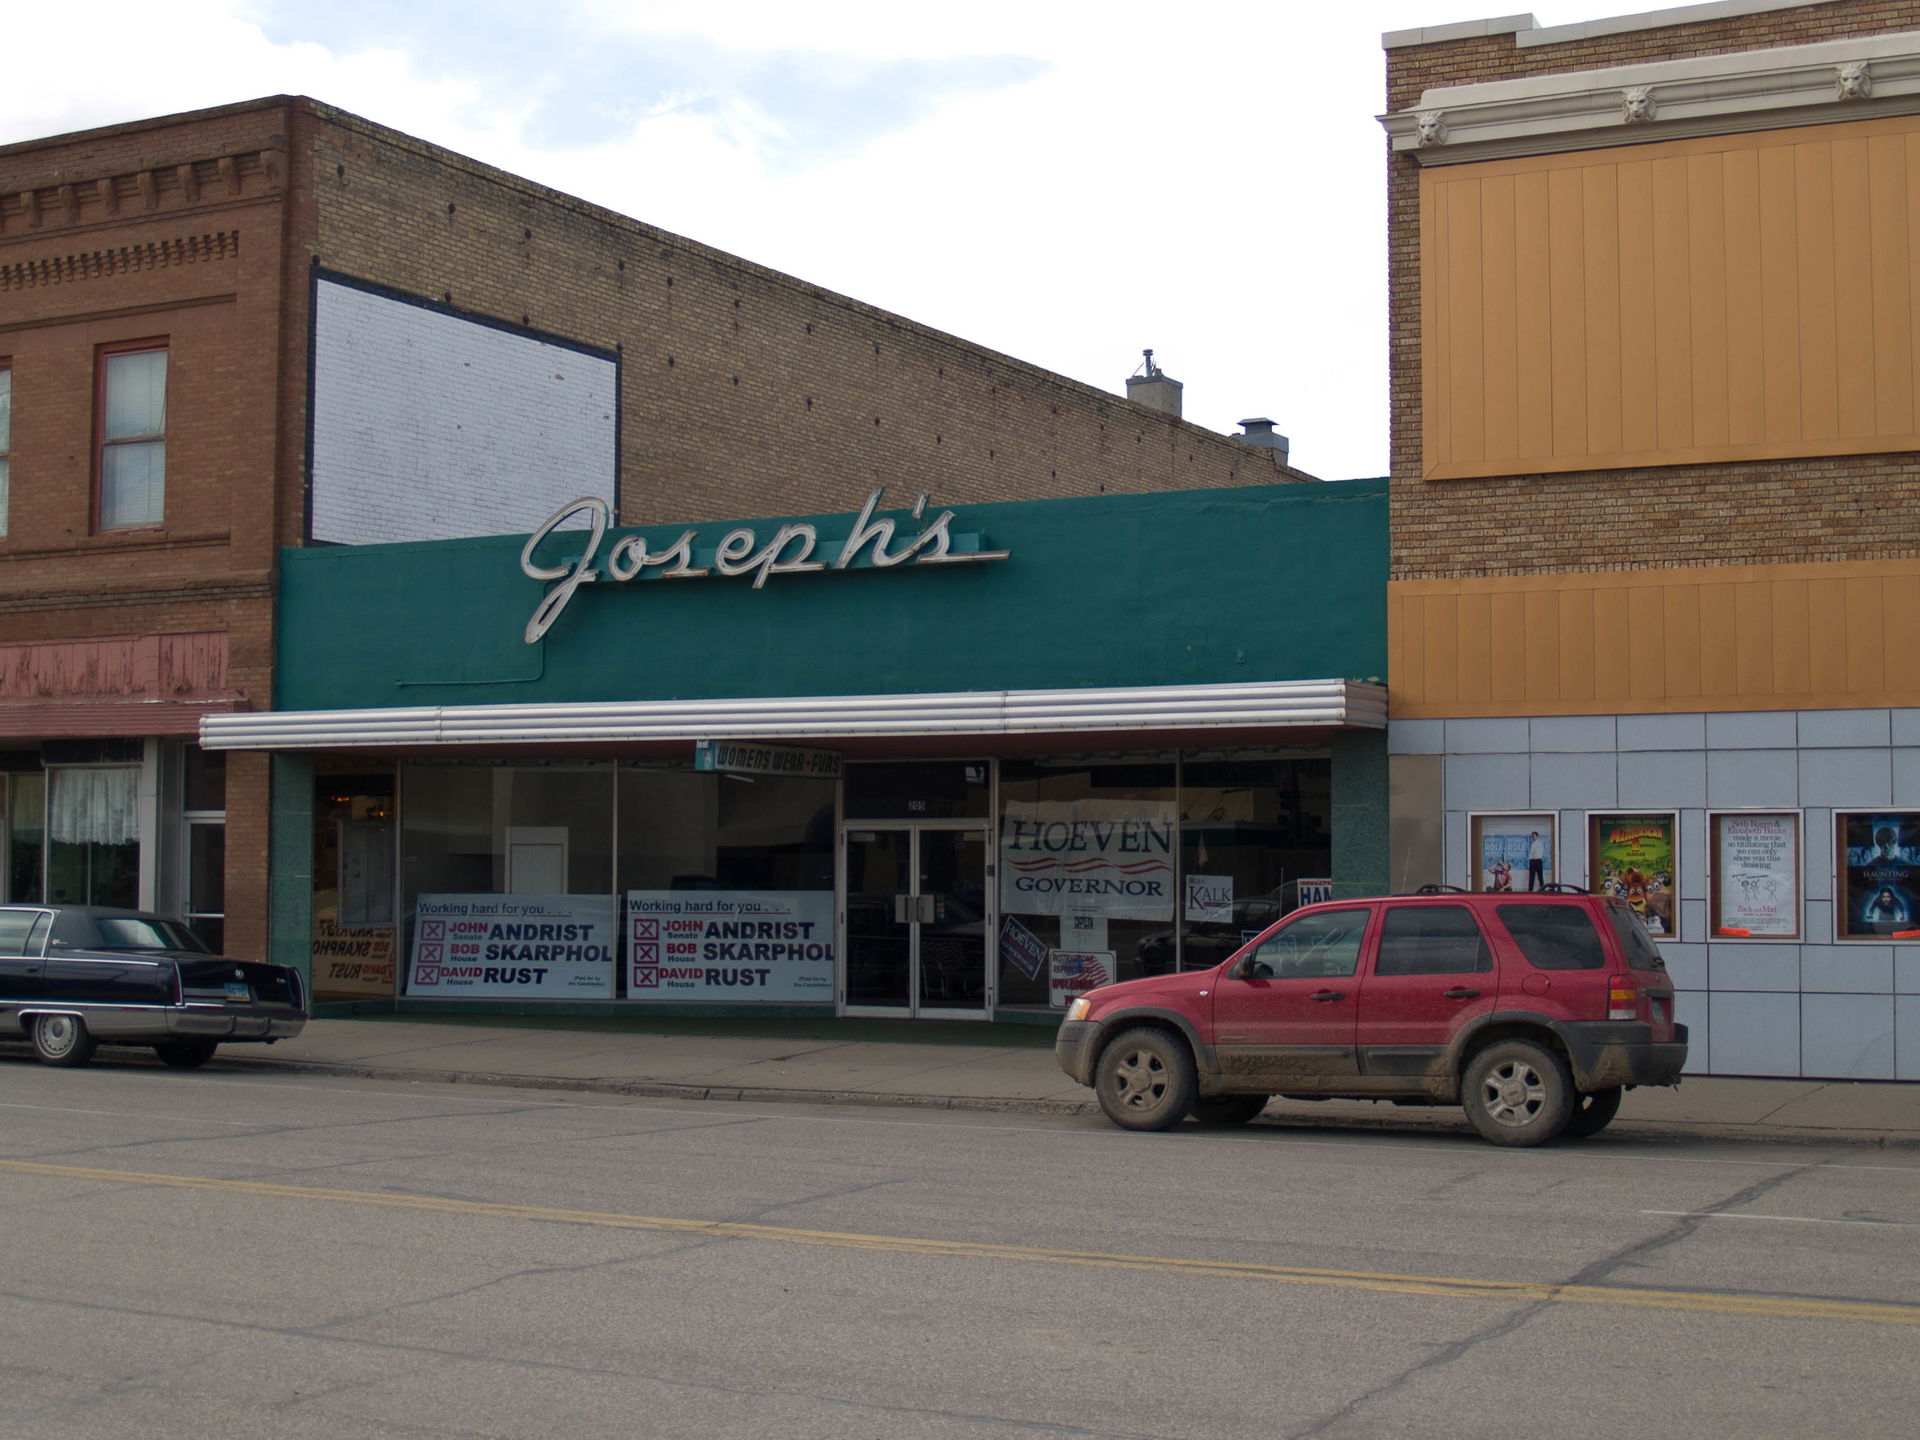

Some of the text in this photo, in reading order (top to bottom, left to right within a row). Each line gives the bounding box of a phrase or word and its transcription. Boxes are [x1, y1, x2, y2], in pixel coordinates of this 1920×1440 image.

[520, 487, 1011, 644] Joseph's
[717, 745, 771, 770] WOMENS
[1008, 820, 1173, 853] HOEVEN
[1762, 848, 1777, 856] only
[1015, 876, 1164, 896] GOVERNOR
[1189, 886, 1232, 909] KALK
[419, 903, 544, 918] Working hard for you
[630, 900, 761, 914] Working hard for you
[448, 922, 594, 941] JOHN ANDRIST
[663, 920, 815, 939] JOHN ANDRIST
[666, 943, 697, 954] BOB
[1005, 922, 1044, 960] HOEVEN
[450, 944, 613, 962] BOB SKARPHOL
[440, 967, 548, 984] DAVID RUST
[447, 978, 473, 986] House
[659, 968, 771, 986] DAVID RUST
